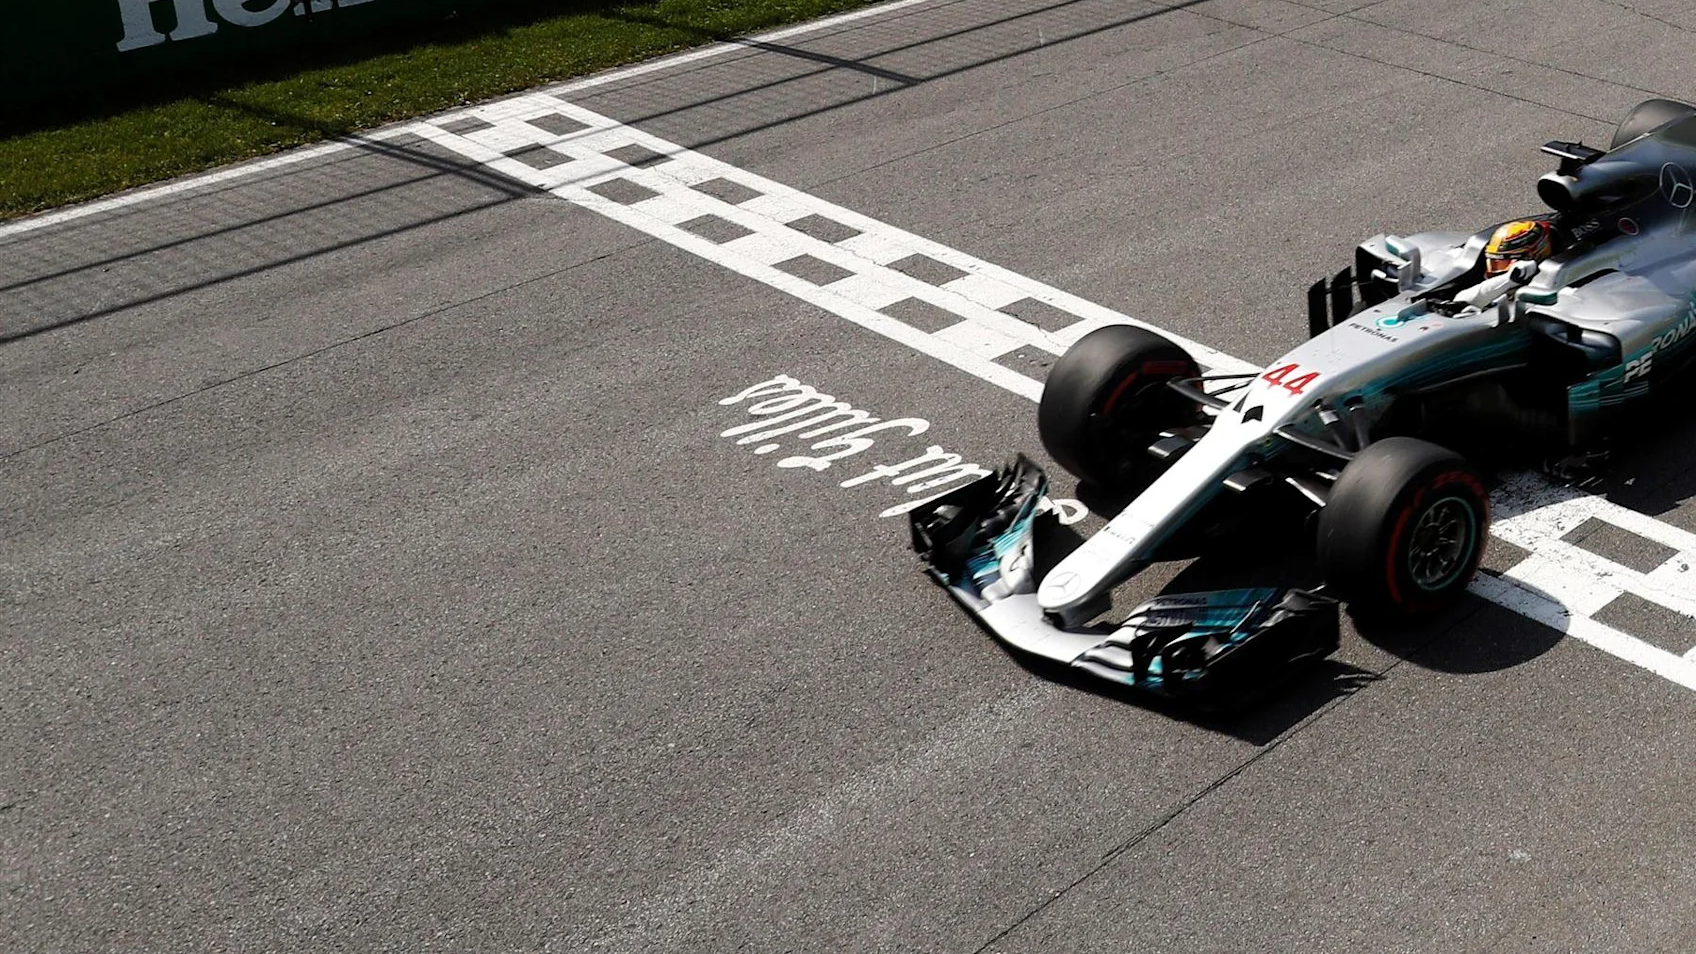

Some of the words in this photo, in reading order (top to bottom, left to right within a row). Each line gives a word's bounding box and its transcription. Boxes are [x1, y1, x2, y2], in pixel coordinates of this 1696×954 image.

[1571, 218, 1600, 239] BOSS
[1349, 322, 1399, 343] PETRONAS
[1262, 363, 1321, 398] 44
